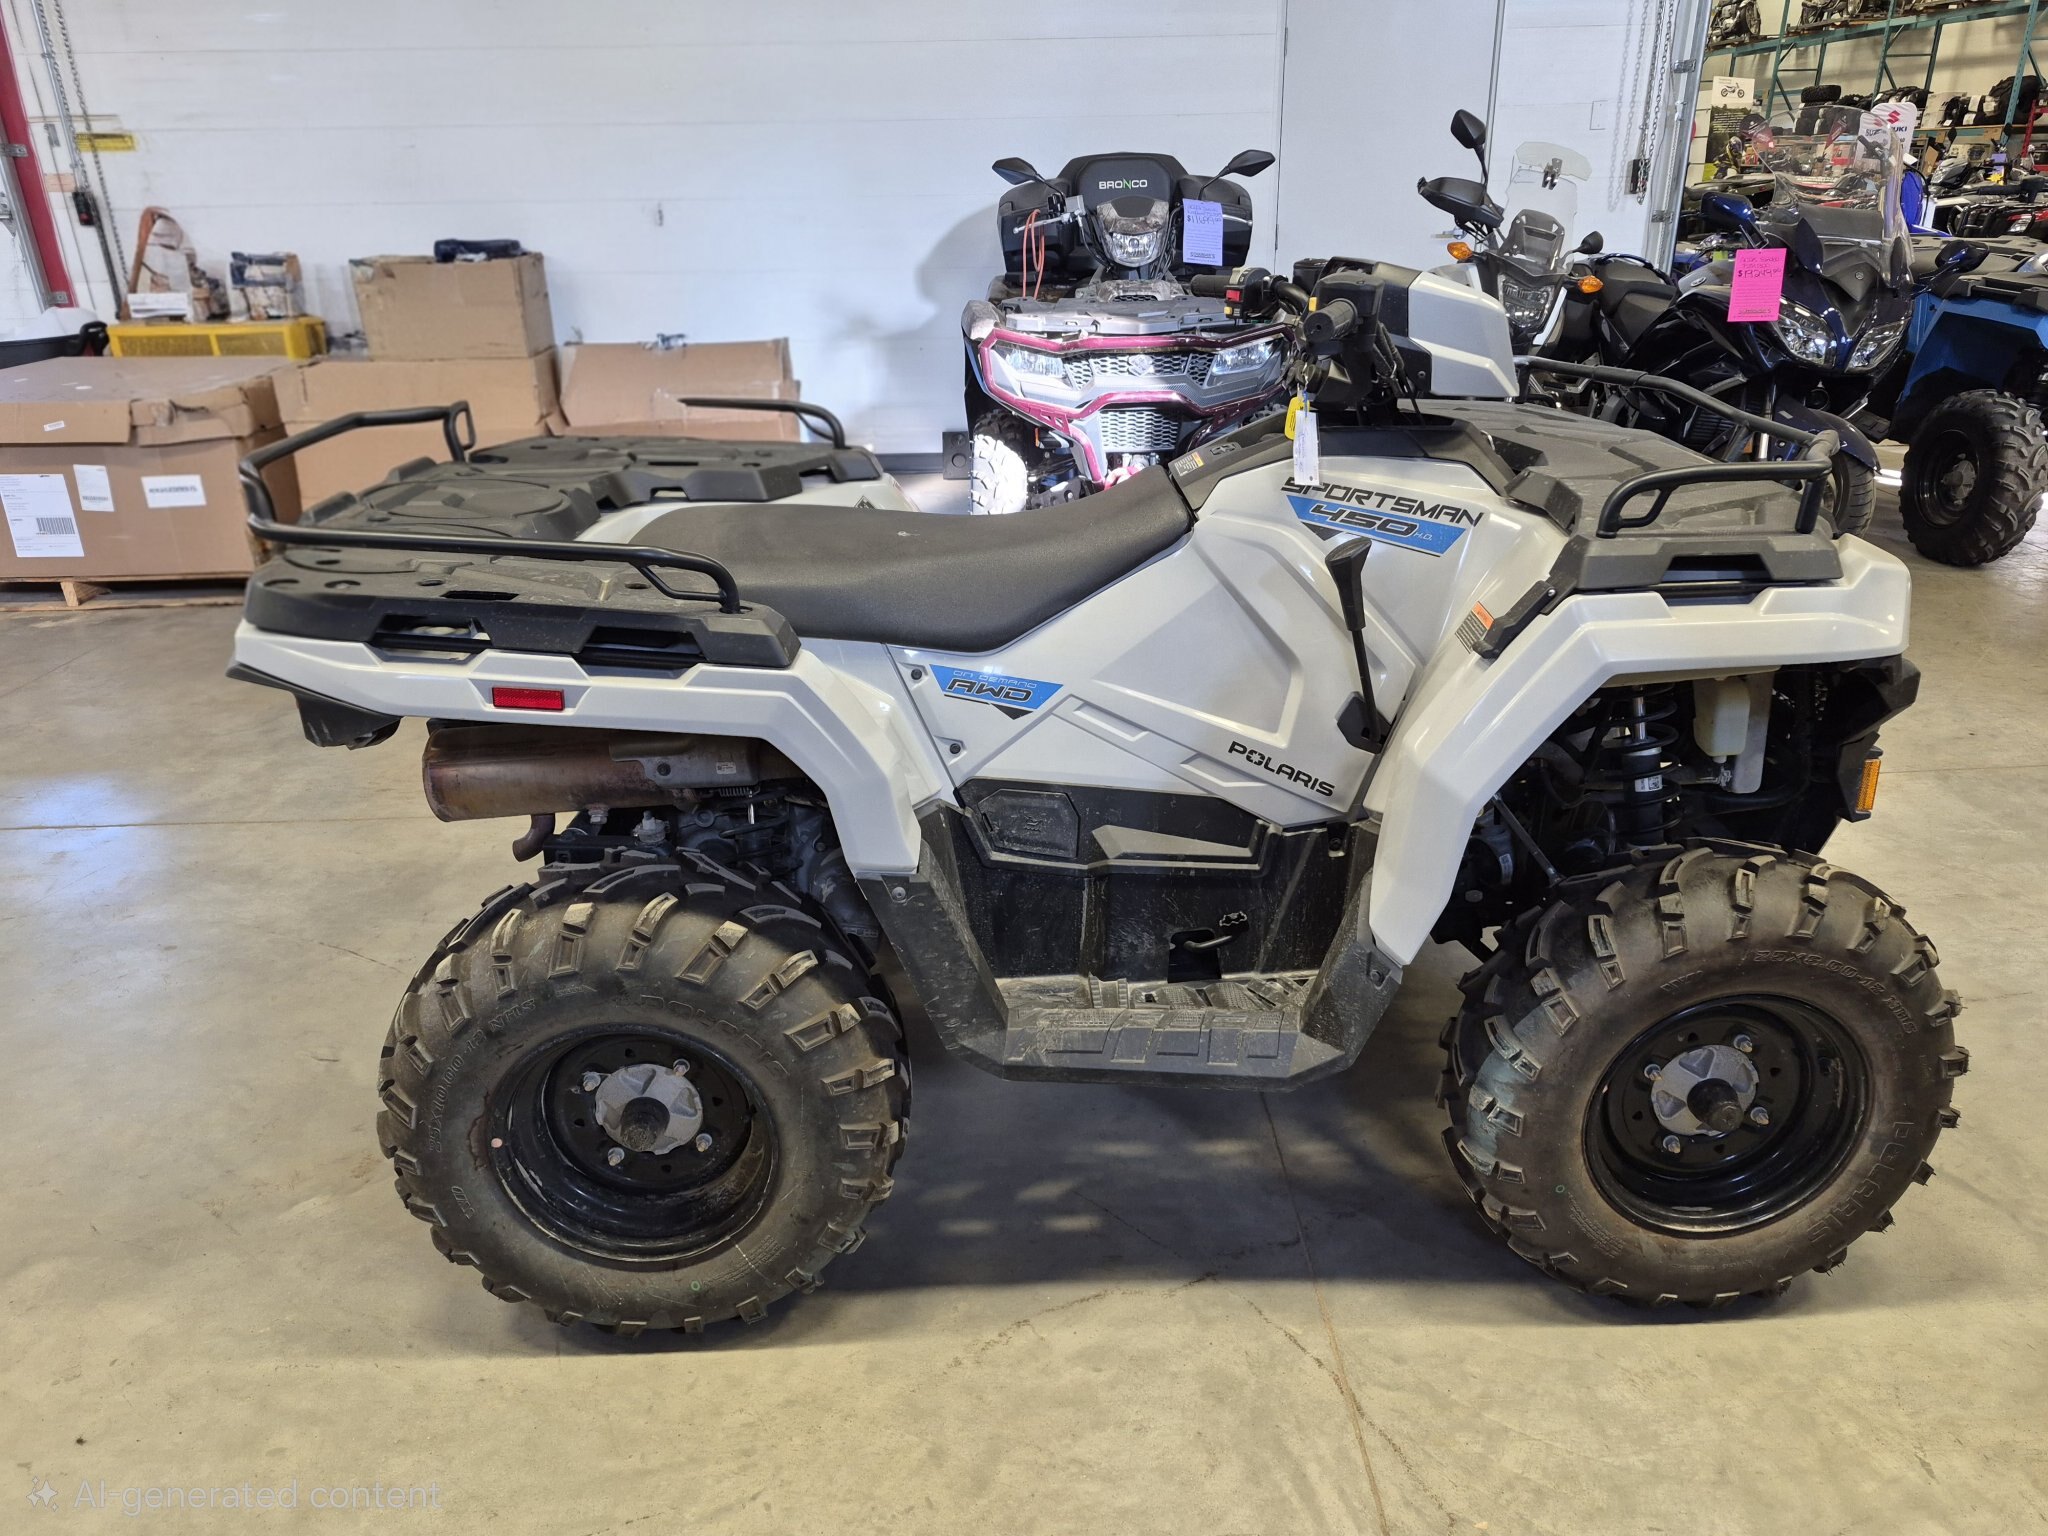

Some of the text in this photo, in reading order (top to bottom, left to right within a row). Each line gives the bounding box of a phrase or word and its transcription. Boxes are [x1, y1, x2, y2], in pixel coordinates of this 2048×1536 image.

[1098, 177, 1148, 190] BRONCO
[1280, 476, 1485, 528] SPORTSMAN
[1309, 502, 1420, 538] 450
[947, 677, 1033, 703] AWD
[1227, 740, 1336, 798] POLARIS
